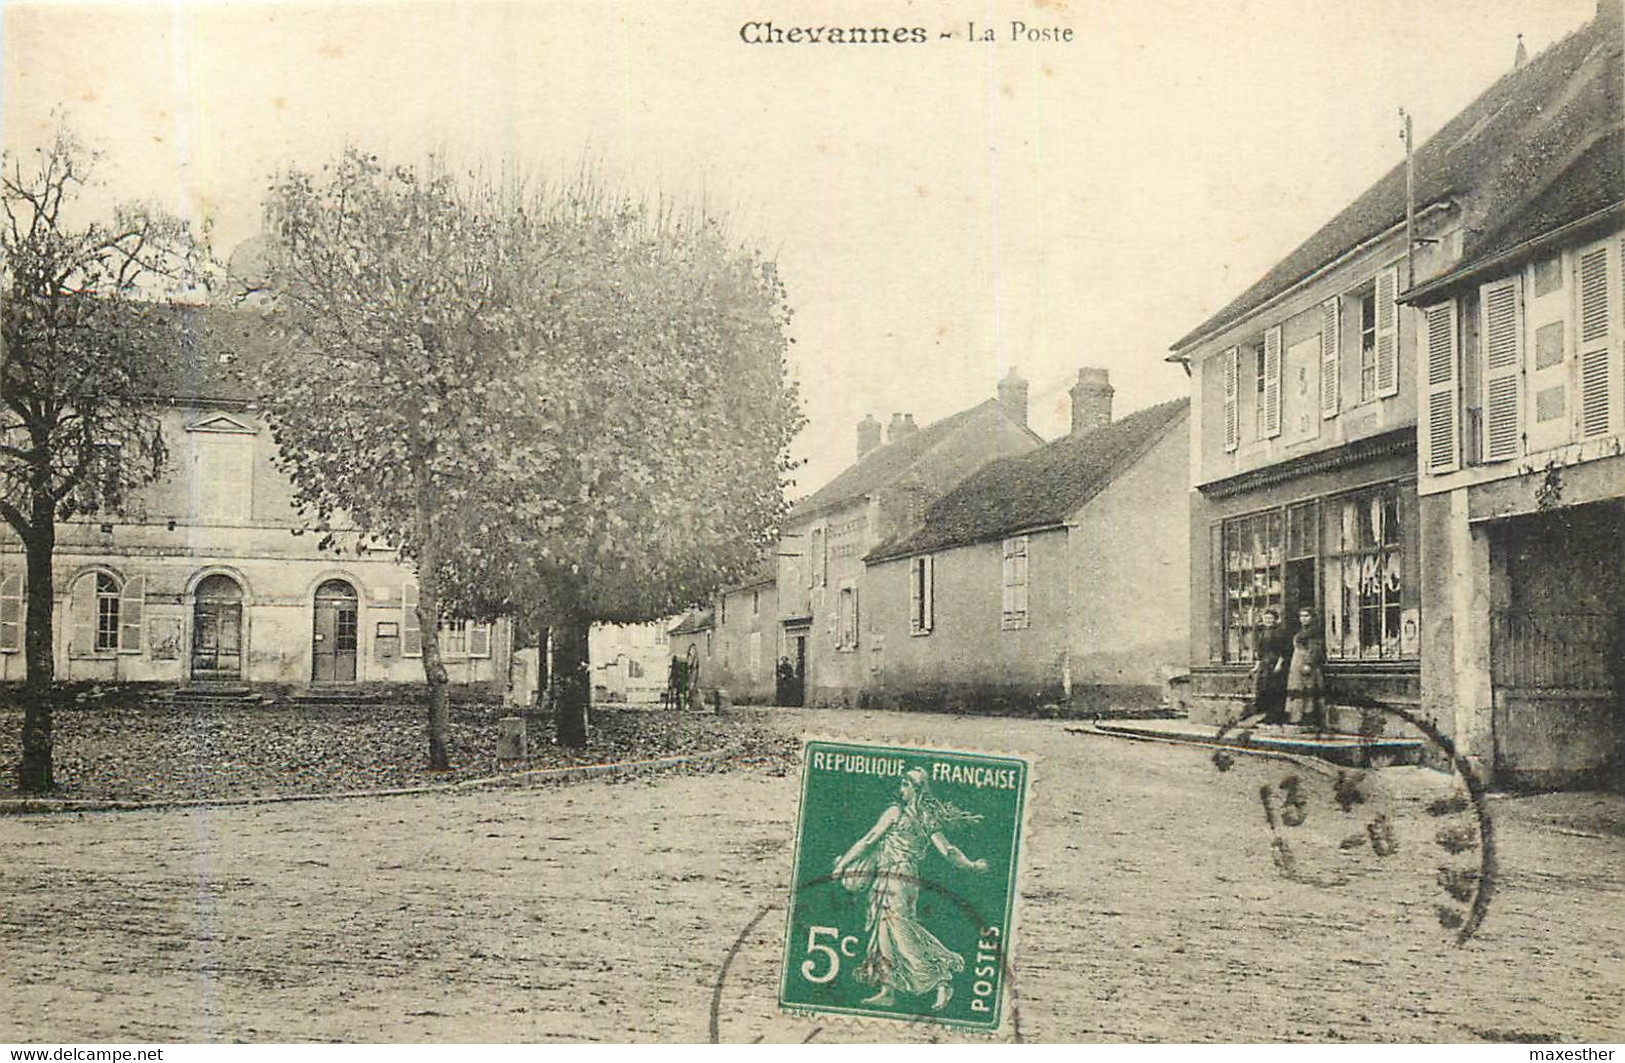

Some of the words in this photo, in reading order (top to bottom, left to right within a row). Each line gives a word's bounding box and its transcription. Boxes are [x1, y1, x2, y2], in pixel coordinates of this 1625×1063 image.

[813, 751, 905, 778] REPUBLIQUE
[932, 762, 1017, 789] FRANÇAISE
[970, 925, 1000, 1012] POSTES
